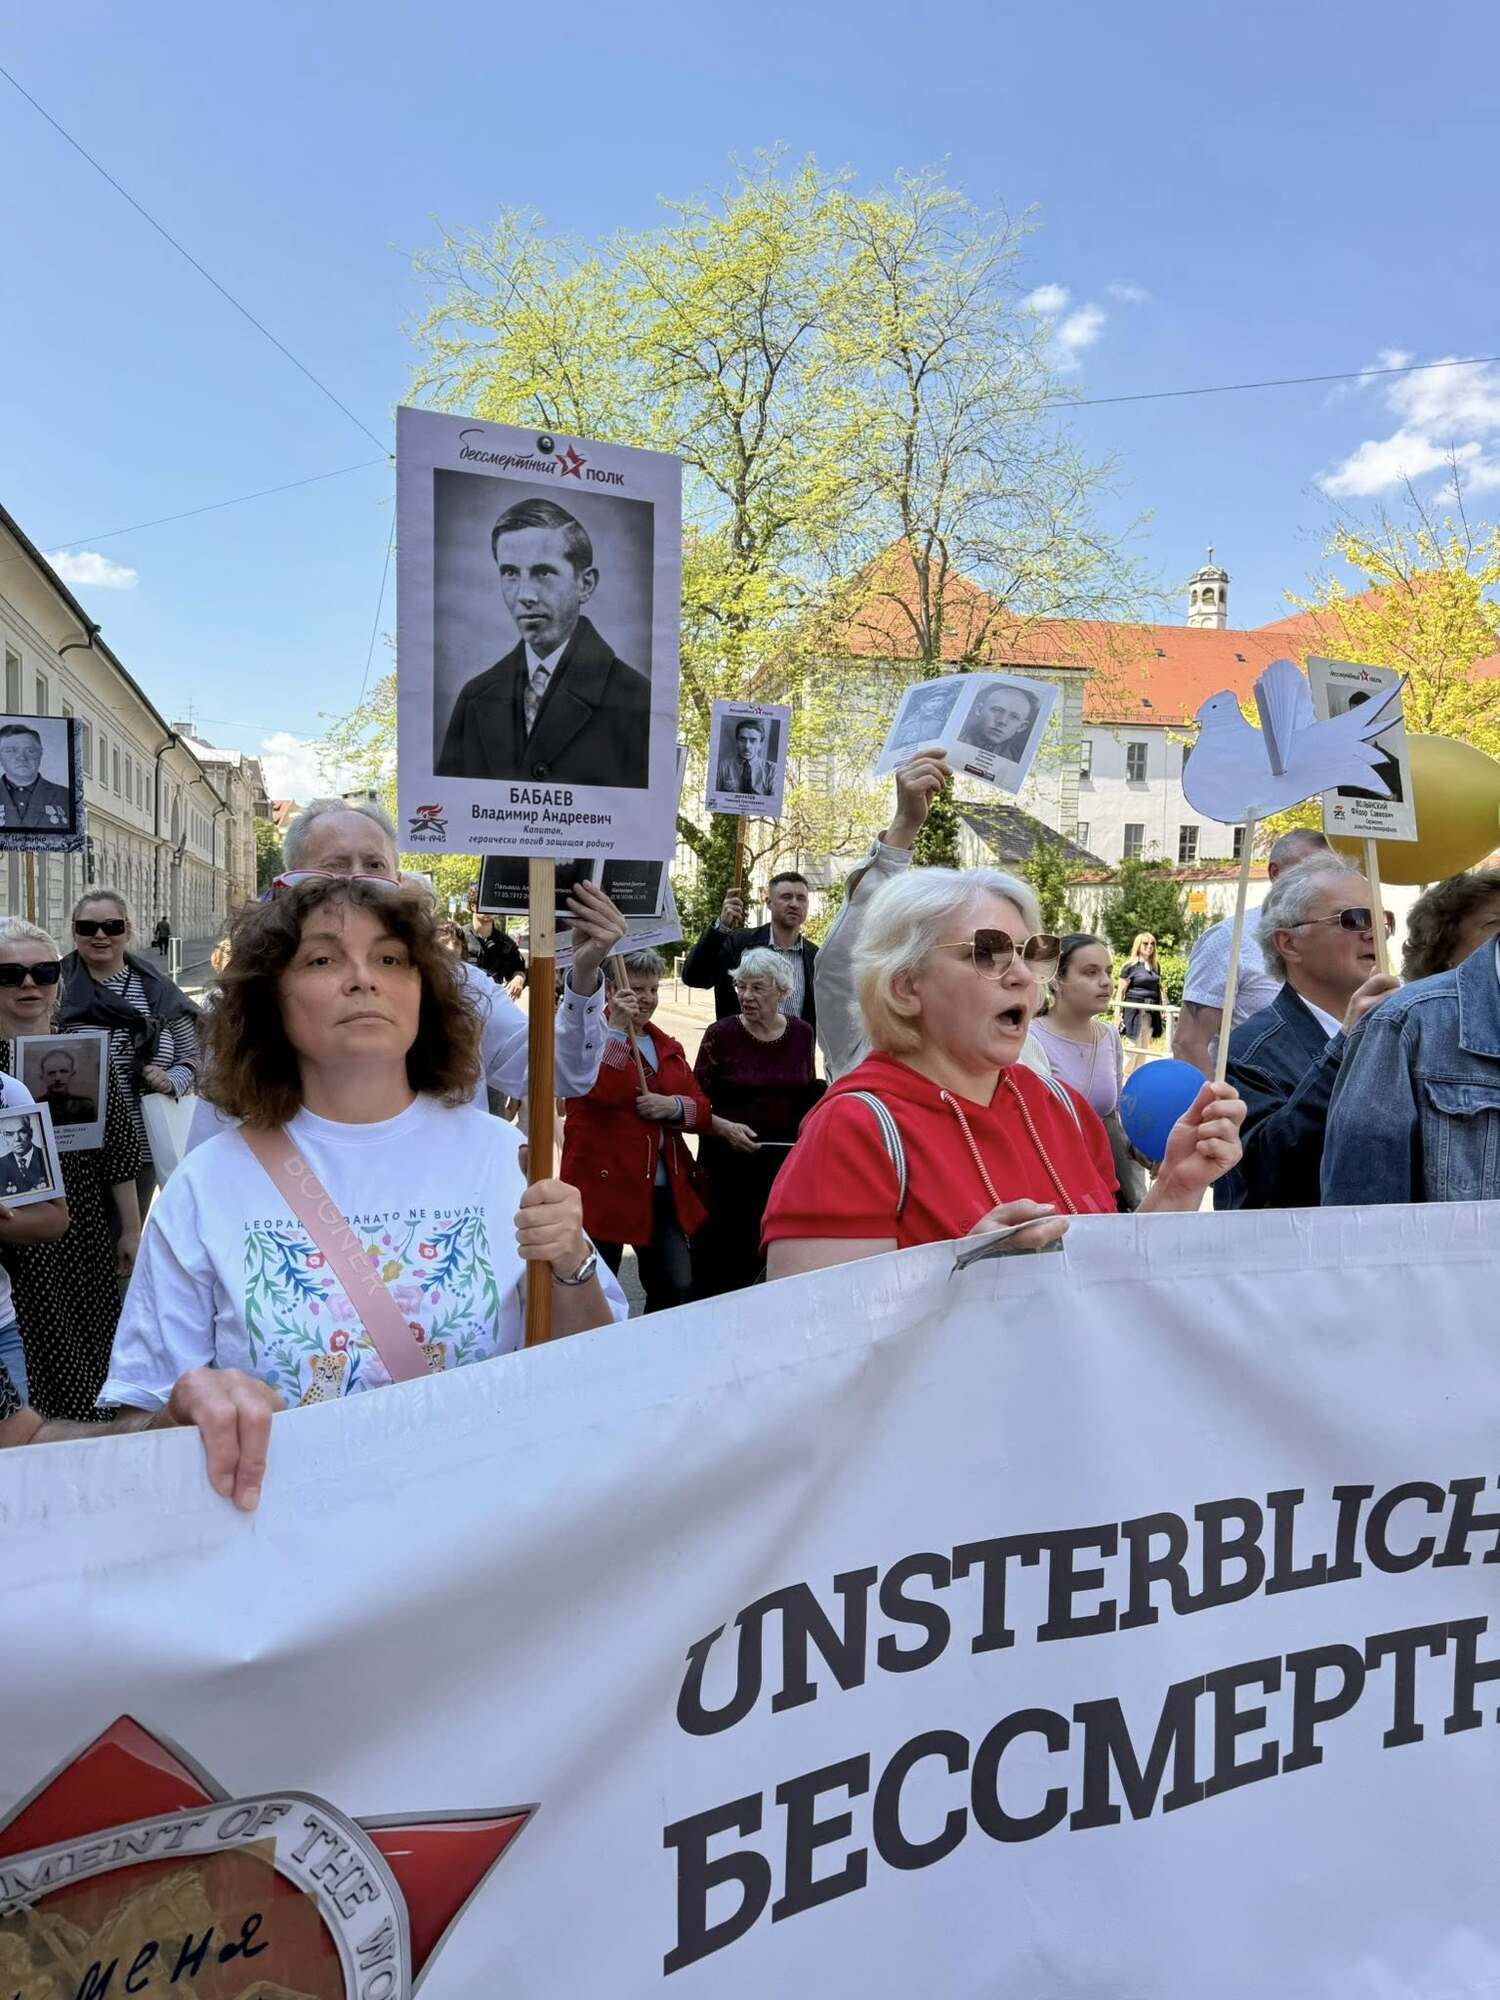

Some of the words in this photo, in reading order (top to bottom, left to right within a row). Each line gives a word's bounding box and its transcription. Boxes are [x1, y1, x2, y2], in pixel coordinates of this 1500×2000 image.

[509, 788, 573, 806] БАБАЕВ
[472, 804, 538, 823] Владимир
[542, 808, 612, 827] Андреевич
[468, 835, 518, 846] героически
[519, 836, 544, 847] погиб
[545, 838, 584, 848] защищая
[585, 840, 615, 850] родину
[523, 826, 563, 836] Капитан,
[244, 1220, 304, 1231] LEOPAR
[409, 1208, 427, 1219] NE
[434, 1205, 486, 1220] BUVAYE
[283, 1157, 386, 1297] BOGNER
[216, 1802, 292, 1841] OF
[291, 1814, 381, 1920] THE
[356, 1914, 398, 2000] WO
